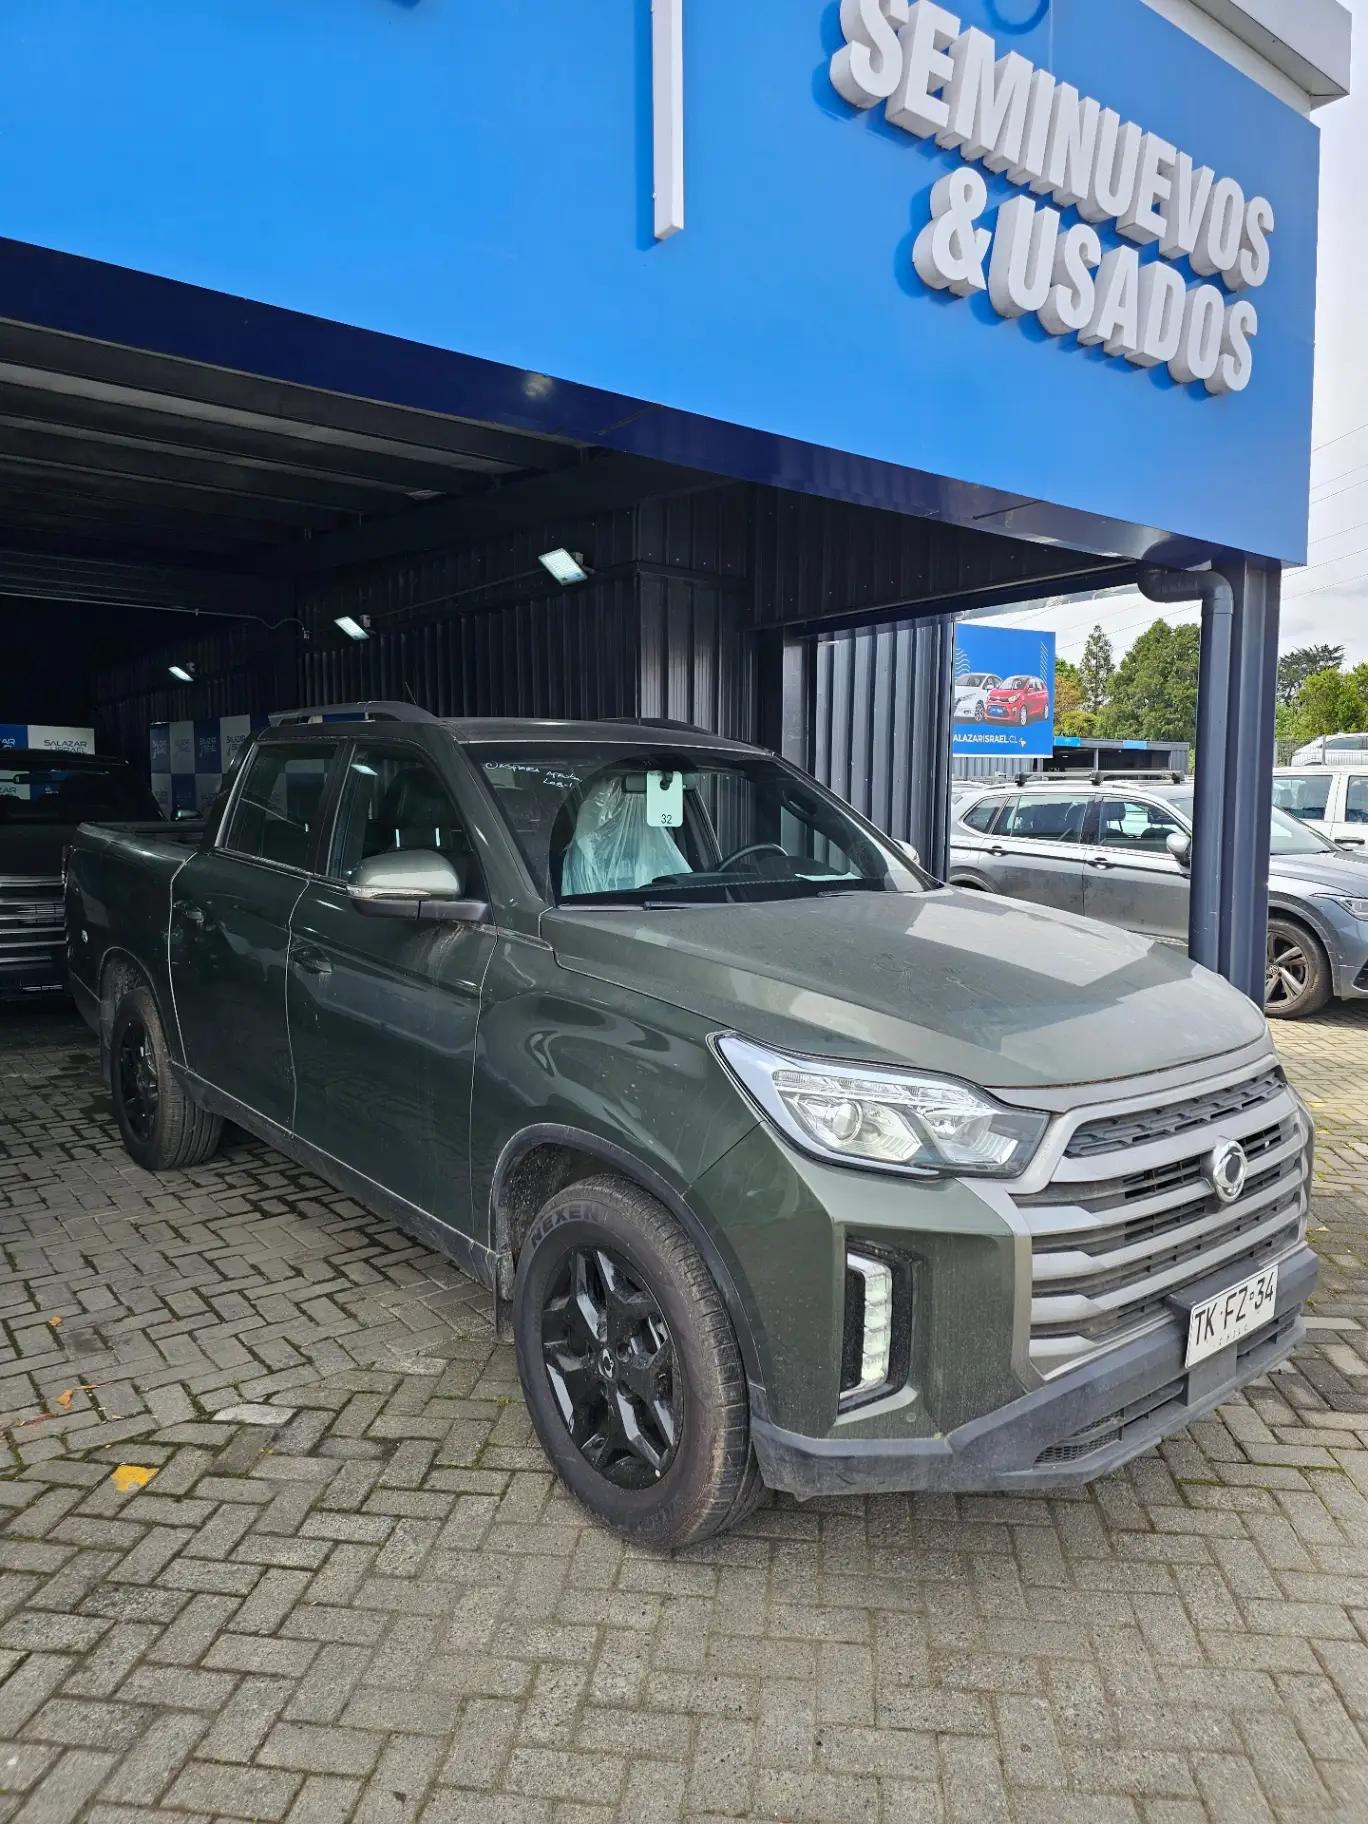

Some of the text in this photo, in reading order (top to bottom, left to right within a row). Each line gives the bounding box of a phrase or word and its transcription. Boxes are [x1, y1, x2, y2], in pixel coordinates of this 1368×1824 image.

[830, 0, 1274, 291] SEMINUEVOS
[912, 167, 1258, 394] & USADOS
[43, 739, 88, 748] SALAZAR
[661, 813, 672, 825] 32
[530, 1201, 606, 1250] NEXEN
